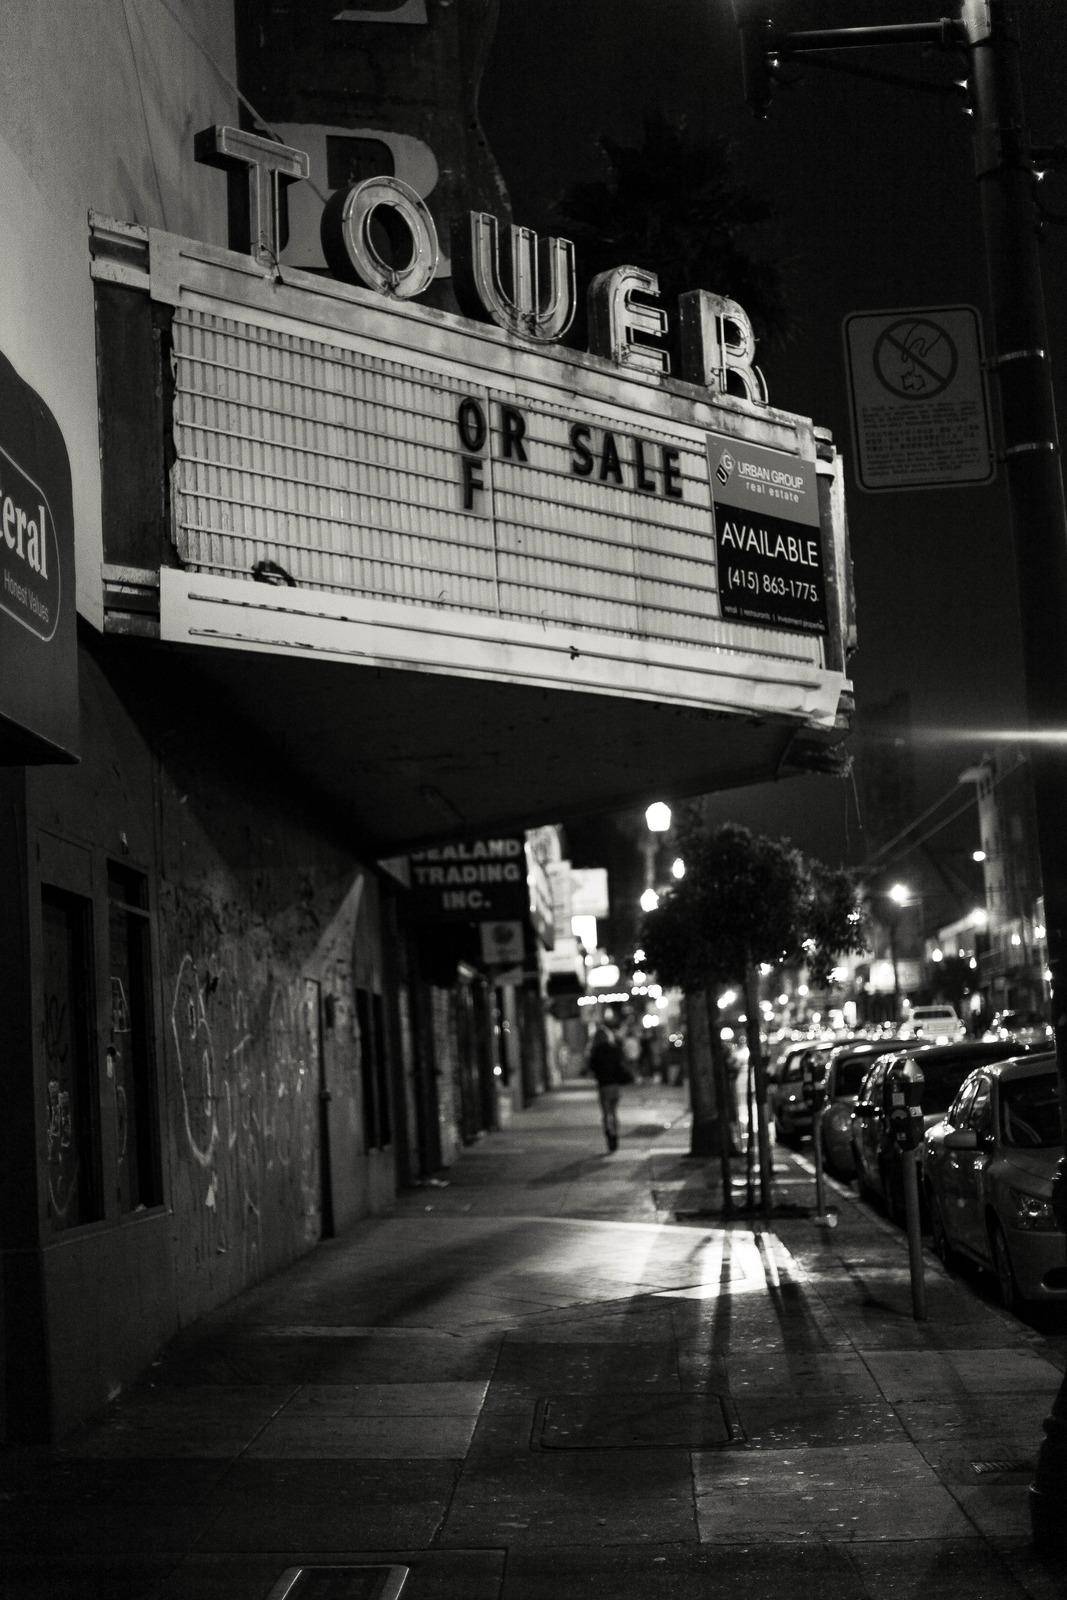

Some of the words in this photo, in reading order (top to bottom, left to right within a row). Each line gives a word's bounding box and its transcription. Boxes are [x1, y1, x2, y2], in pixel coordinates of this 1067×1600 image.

[195, 126, 768, 405] TOWER
[569, 423, 683, 498] SALE
[737, 460, 770, 481] URBAN
[770, 469, 804, 489] GROUP
[746, 481, 766, 495] real
[768, 487, 800, 503] estate
[721, 521, 819, 568] AVAILABLE
[4, 568, 28, 607] Honest
[28, 587, 50, 624] Values
[728, 566, 760, 595] (415)
[762, 574, 819, 603] 863-1775
[412, 862, 522, 886] TRADING
[441, 888, 493, 911] INC.
